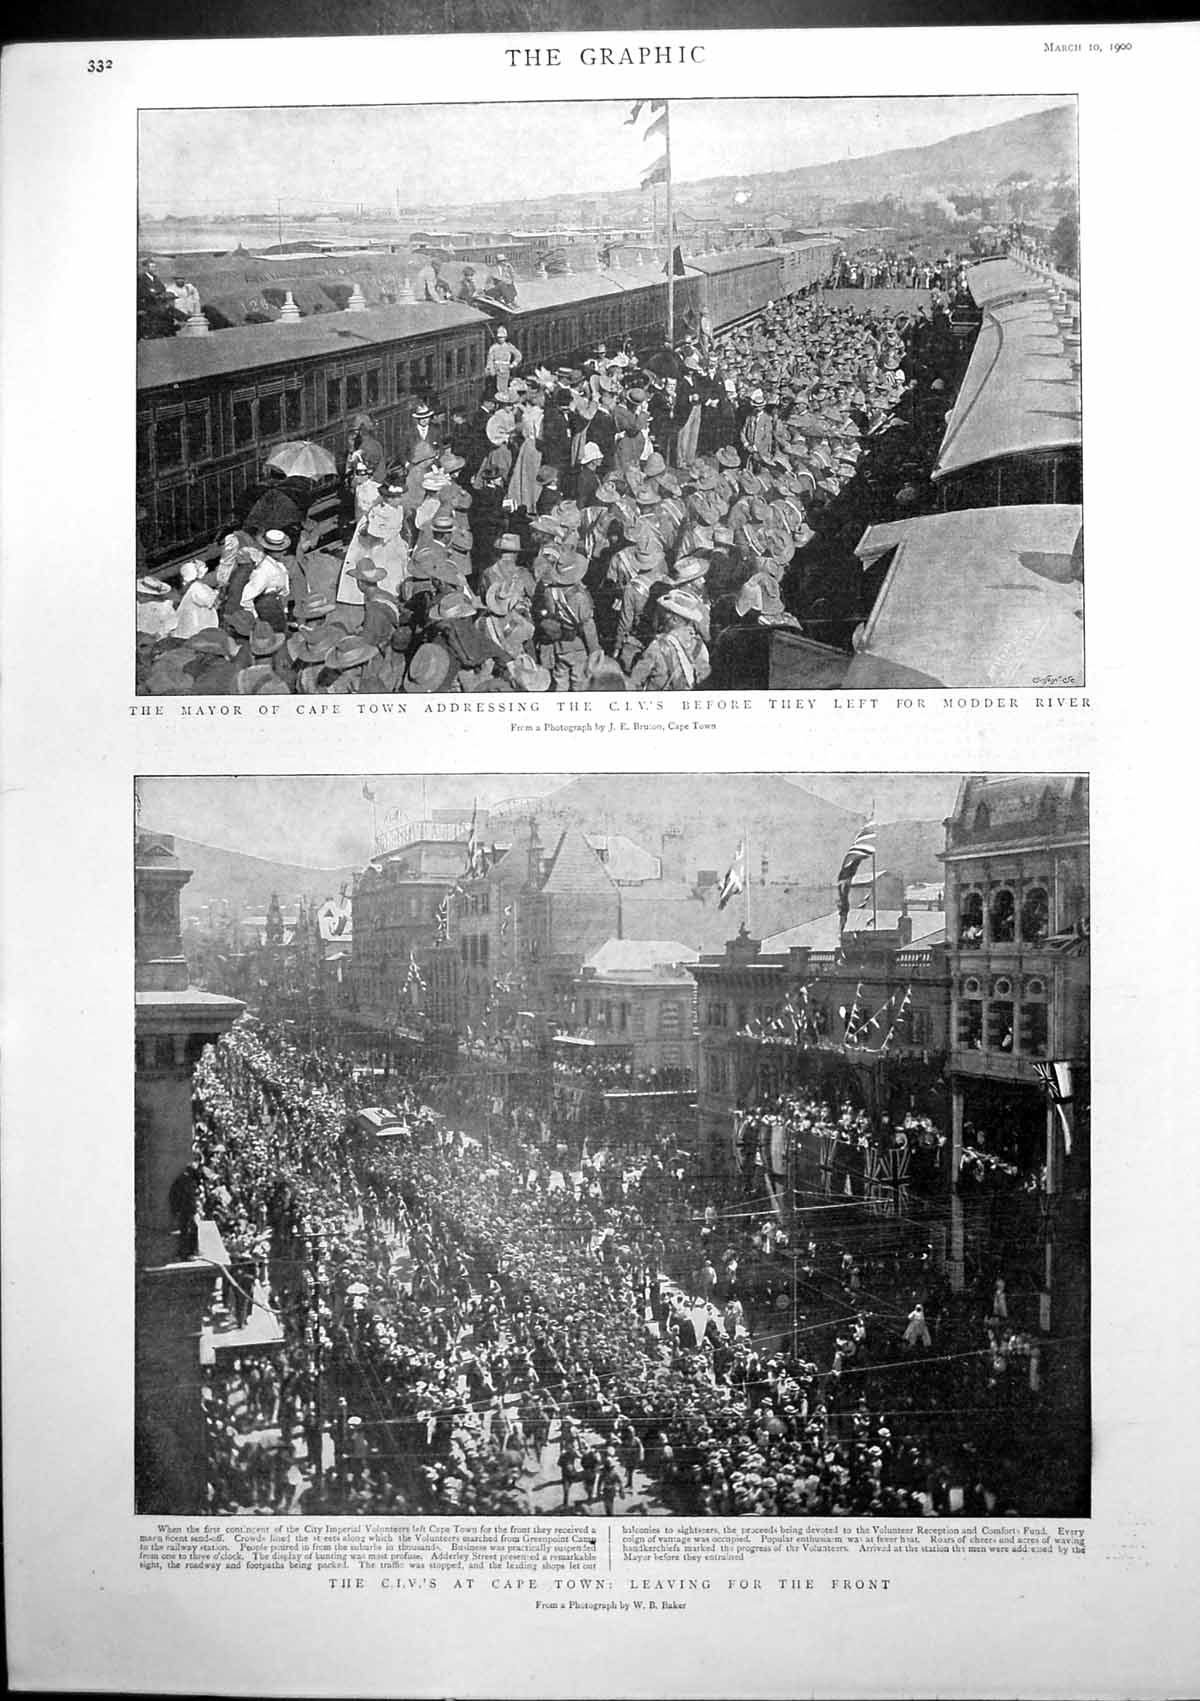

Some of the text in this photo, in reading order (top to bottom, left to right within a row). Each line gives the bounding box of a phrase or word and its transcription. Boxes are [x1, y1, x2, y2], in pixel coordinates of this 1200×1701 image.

[504, 45, 705, 67] THE GRAPHIC
[87, 59, 113, 73] 332
[129, 705, 164, 716] THE
[181, 705, 244, 715] MAYOR
[258, 704, 280, 715] OF
[296, 704, 342, 714] CAPE
[357, 703, 407, 714] TOWN
[424, 702, 540, 713] ADDRESSING
[556, 701, 592, 712] THE
[682, 700, 752, 711] BEFORE
[768, 699, 816, 710] THEY
[834, 699, 879, 709] LEFT
[896, 698, 926, 709] FOR
[943, 698, 1019, 708] MODDER
[1036, 697, 1090, 707] RIVER
[511, 723, 533, 732] From
[544, 722, 592, 733] Photograph
[595, 722, 605, 733] by
[668, 721, 689, 732] Cape
[692, 721, 717, 729] Town
[158, 1525, 182, 1533] When
[187, 1525, 200, 1533] the
[204, 1525, 220, 1533] first
[274, 1525, 282, 1533] of
[287, 1525, 299, 1533] the
[304, 1525, 322, 1535] City
[412, 1525, 426, 1533] left
[429, 1525, 450, 1535] Cape
[454, 1525, 477, 1533] Town
[480, 1525, 491, 1533] for
[495, 1525, 507, 1533] the
[510, 1525, 530, 1533] front
[534, 1525, 552, 1535] they
[724, 1526, 736, 1534] the
[780, 1526, 803, 1536] being
[856, 1526, 870, 1534] the
[872, 1526, 913, 1534] Volunteer
[916, 1526, 959, 1537] Reception
[961, 1526, 976, 1535] and
[296, 1534, 308, 1542] the
[369, 1534, 392, 1542] which
[398, 1534, 411, 1542] the
[416, 1534, 460, 1542] Volunteers
[463, 1534, 497, 1542] marched
[500, 1534, 520, 1542] from
[622, 1534, 644, 1545] coign
[648, 1534, 656, 1543] of
[761, 1535, 792, 1545] Popular
[930, 1535, 955, 1543] Roars
[957, 1535, 966, 1543] of
[999, 1535, 1014, 1543] and
[1042, 1535, 1050, 1544] of
[151, 1543, 163, 1551] the
[270, 1543, 298, 1553] poured
[302, 1543, 309, 1551] in
[312, 1543, 331, 1551] from
[335, 1543, 347, 1551] the
[386, 1543, 393, 1551] in
[684, 1544, 715, 1552] marked
[773, 1544, 781, 1552] of
[786, 1544, 799, 1552] the
[905, 1544, 918, 1552] the
[921, 1544, 949, 1552] station
[1058, 1545, 1068, 1555] by
[1072, 1545, 1085, 1553] the
[139, 1552, 158, 1560] from
[190, 1552, 210, 1560] three
[252, 1552, 269, 1560] The
[272, 1552, 301, 1562] display
[304, 1552, 312, 1560] of
[316, 1552, 347, 1562] bunting
[432, 1552, 469, 1562] Adderley
[472, 1552, 496, 1560] Street
[550, 1552, 596, 1560] remarkable
[654, 1552, 680, 1560] before
[684, 1552, 700, 1562] they
[168, 1560, 180, 1569] the
[185, 1560, 220, 1571] roadway
[226, 1560, 241, 1569] and
[290, 1561, 312, 1571] being
[359, 1561, 374, 1569] The
[469, 1561, 484, 1569] and
[489, 1561, 501, 1569] the
[542, 1561, 564, 1571] shops
[570, 1561, 580, 1569] let
[583, 1561, 596, 1569] out
[329, 1579, 364, 1589] THE
[454, 1579, 475, 1589] AT
[491, 1579, 537, 1589] CAPE
[554, 1579, 612, 1589] TOWN:
[630, 1579, 711, 1589] LEAVING
[728, 1579, 762, 1589] FOR
[778, 1579, 814, 1589] THE
[832, 1579, 890, 1589] FRONT
[536, 1600, 558, 1609] From
[569, 1600, 617, 1611] Photograph
[620, 1600, 629, 1611] by
[634, 1600, 645, 1609] W.
[649, 1600, 658, 1609] B.
[662, 1600, 686, 1609] Baker
